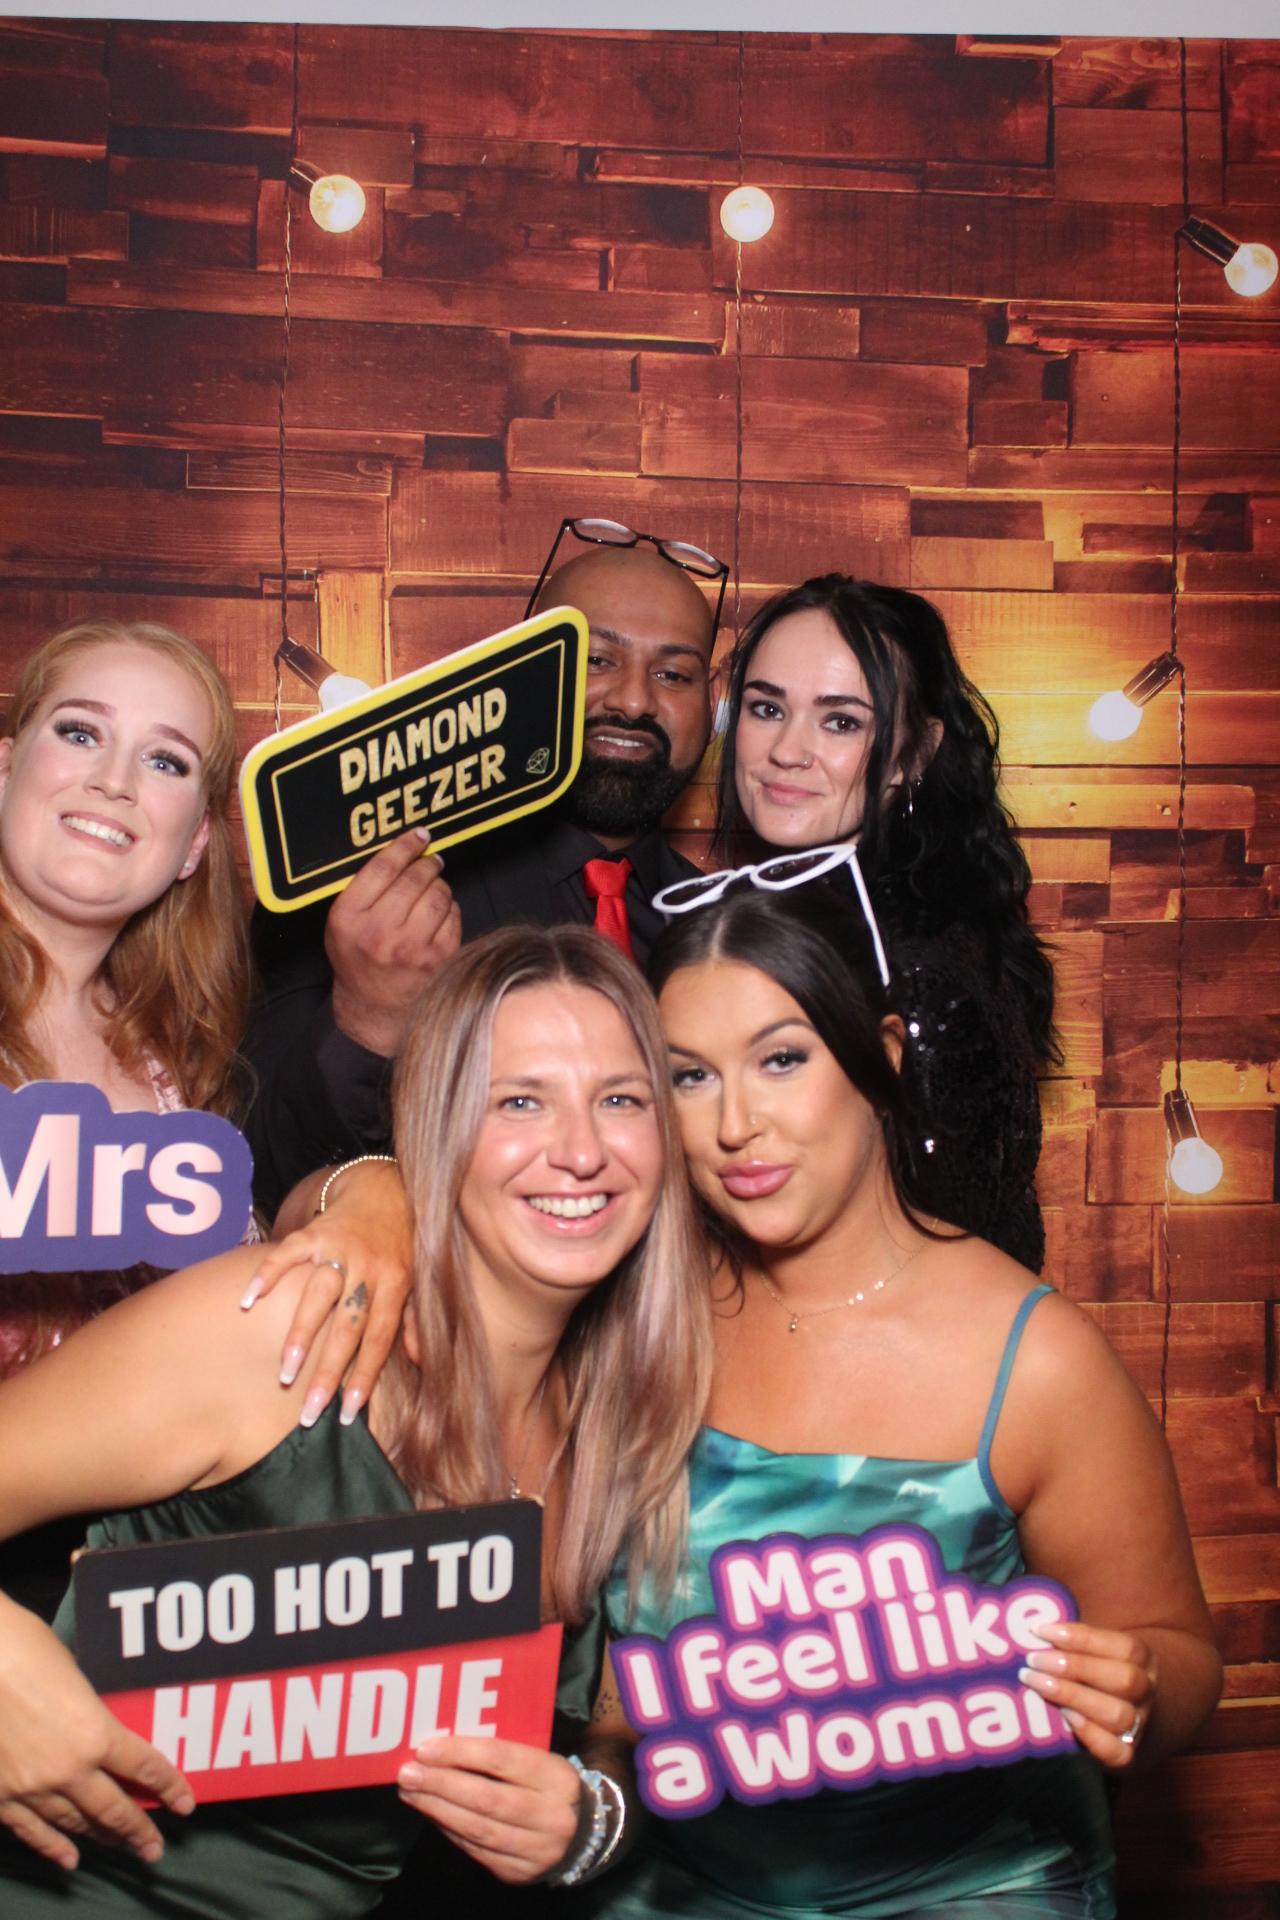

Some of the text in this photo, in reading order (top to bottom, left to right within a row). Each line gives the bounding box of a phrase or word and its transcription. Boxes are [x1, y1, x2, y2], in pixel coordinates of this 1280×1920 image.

[339, 687, 507, 796] DIAMOND
[350, 744, 506, 848] GEEZER
[0, 1113, 223, 1239] Mrs
[109, 1534, 514, 1658] TOO HOT TO
[726, 1541, 929, 1625] Man
[628, 1591, 1060, 1719] I feel like
[152, 1658, 502, 1773] HANDLE
[652, 1748, 707, 1802] a
